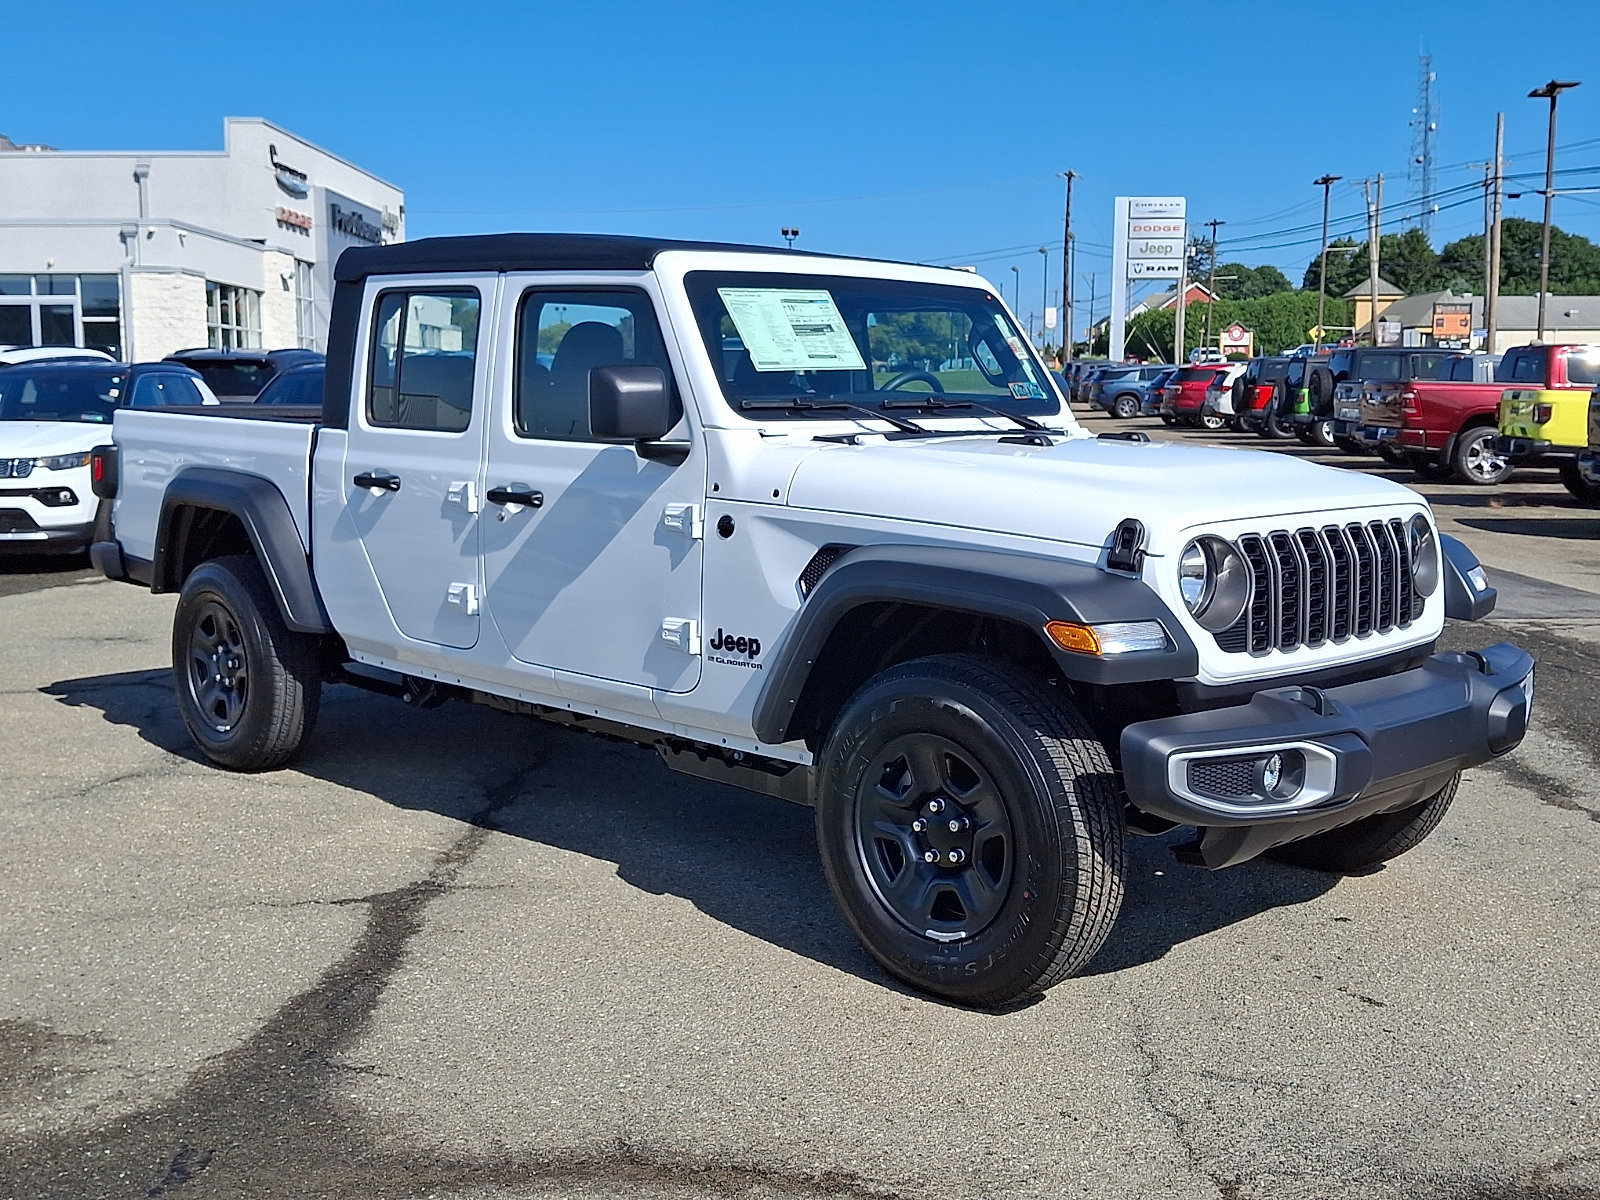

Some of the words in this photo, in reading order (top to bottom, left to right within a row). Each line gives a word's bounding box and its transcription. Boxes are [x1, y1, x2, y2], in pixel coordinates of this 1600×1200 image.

[1139, 241, 1173, 255] Jeep
[710, 627, 761, 660] Jeep
[715, 656, 763, 670] GLADIATOR
